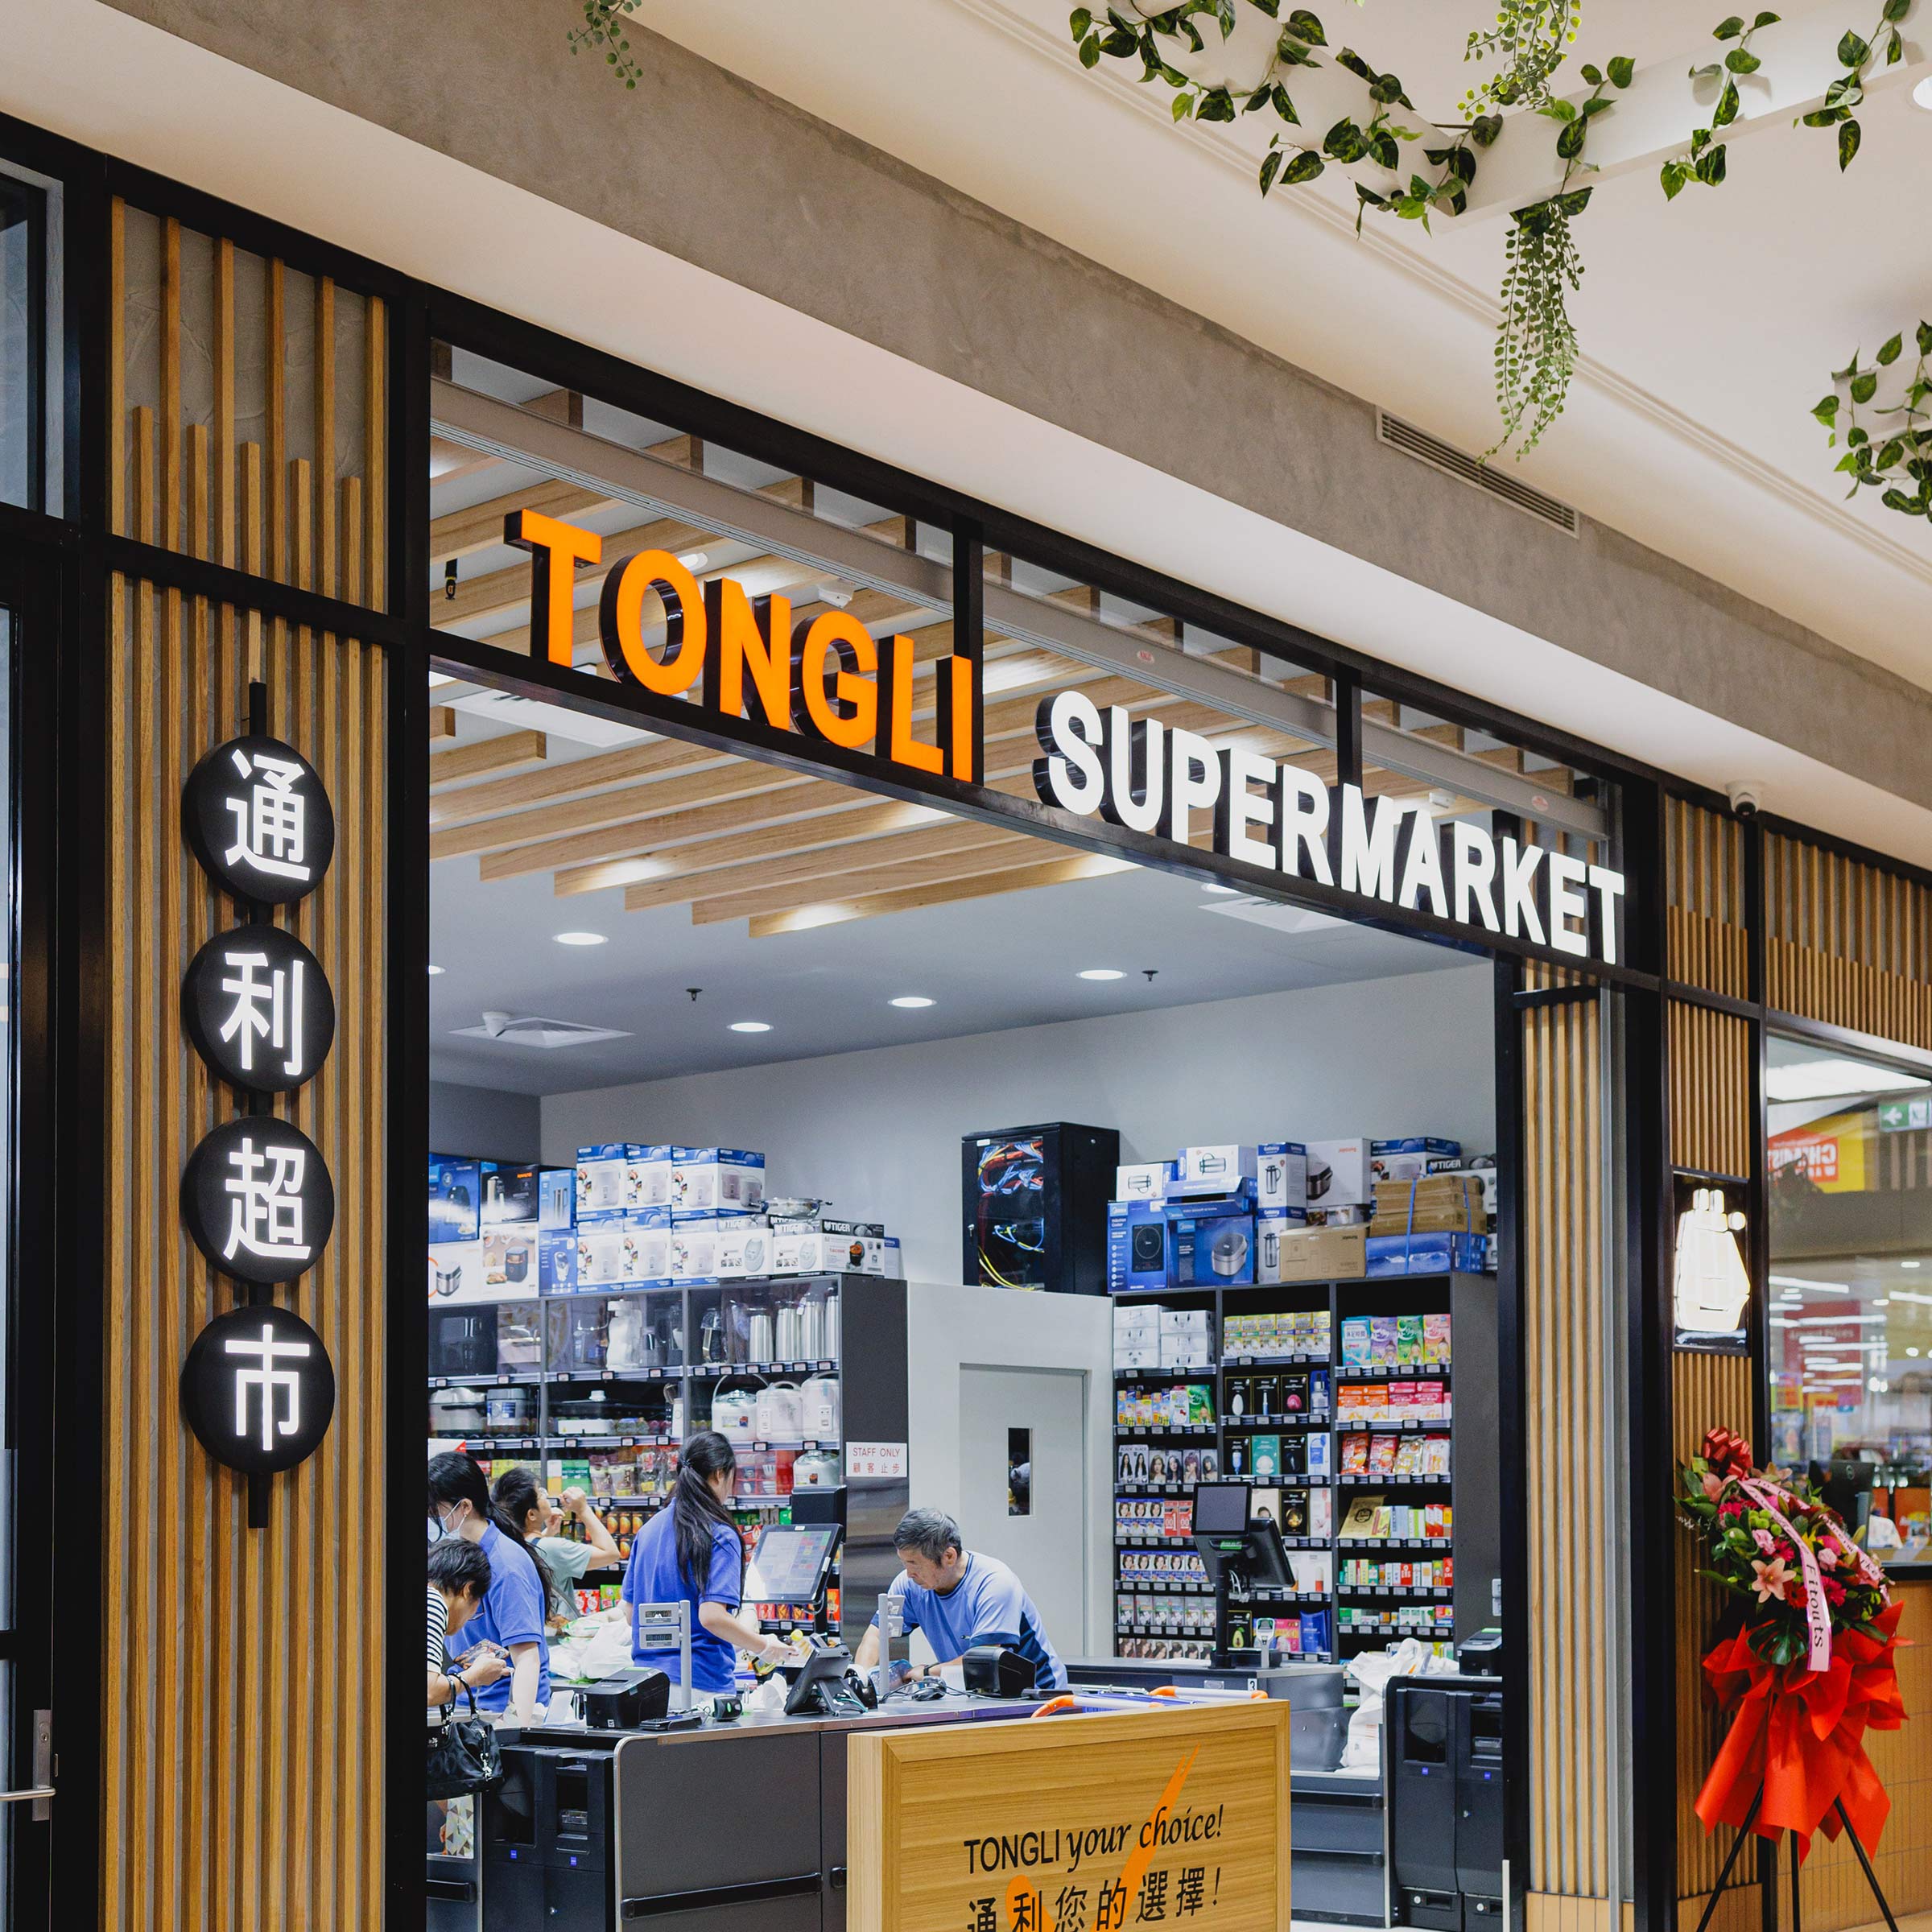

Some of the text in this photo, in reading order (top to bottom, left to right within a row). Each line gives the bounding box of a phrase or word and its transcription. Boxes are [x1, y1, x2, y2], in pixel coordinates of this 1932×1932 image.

[520, 509, 1625, 965] TONGLI SUPERMARKET
[220, 748, 312, 1451] 通利超市
[1438, 1159, 1461, 1170] TIGER
[830, 1222, 850, 1232] TIGER
[852, 1447, 901, 1457] STAFF ONLY
[1806, 1563, 1824, 1648] Fitouts
[964, 1805, 1224, 1874] TONGLI your choice!
